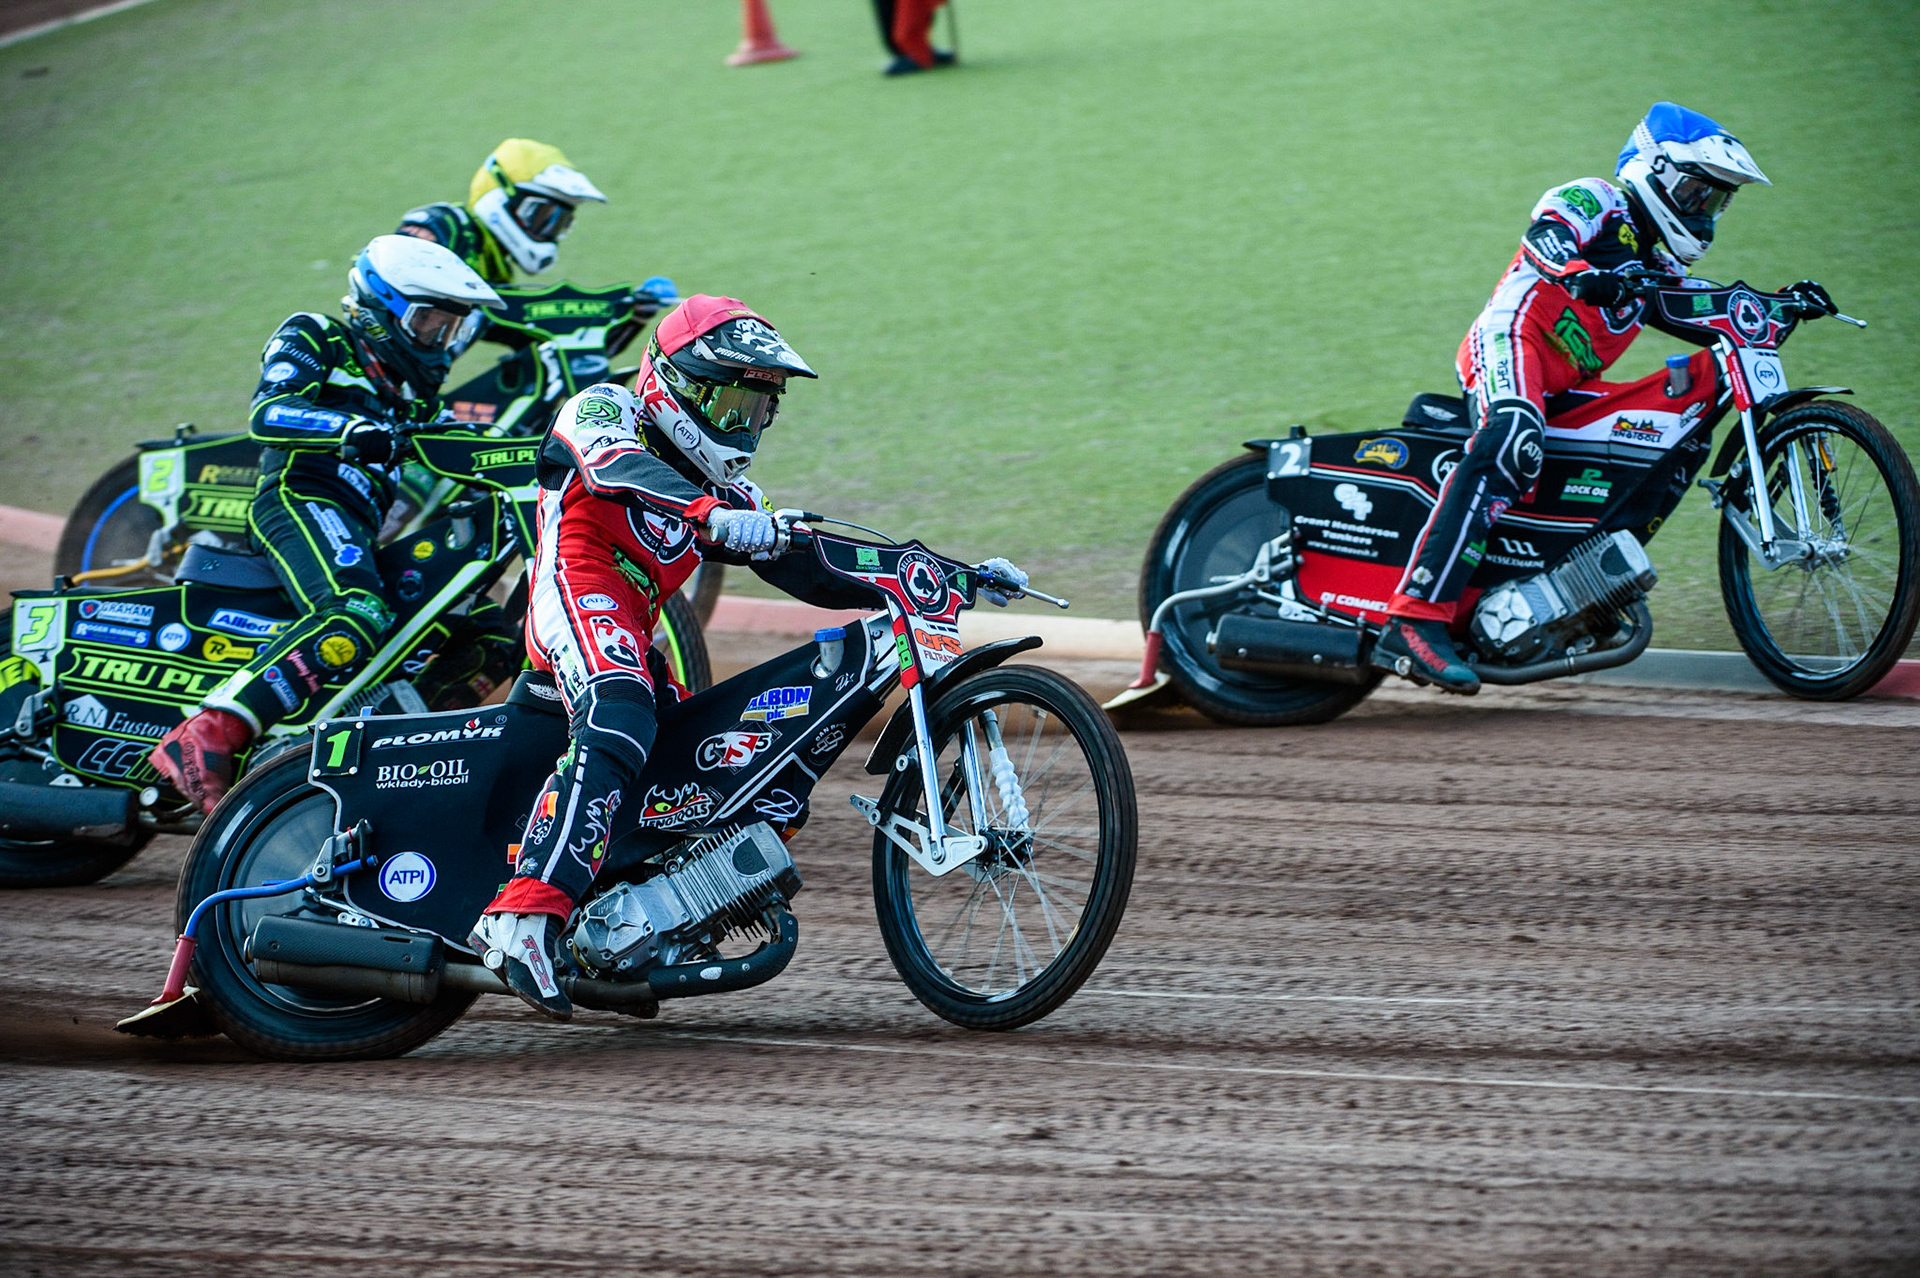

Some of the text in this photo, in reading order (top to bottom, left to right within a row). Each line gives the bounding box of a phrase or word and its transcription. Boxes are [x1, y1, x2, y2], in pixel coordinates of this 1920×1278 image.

[677, 425, 697, 445] ATPI
[480, 451, 515, 466] TRU
[1279, 443, 1302, 476] 2
[148, 457, 176, 492] 2
[1563, 485, 1592, 495] ROCK
[1294, 515, 1399, 539] Grant Henderson
[1322, 529, 1373, 545] Tankers
[914, 554, 929, 564] VUE
[20, 606, 56, 645] 3
[217, 614, 271, 632] Allied
[81, 656, 158, 686] TRU
[746, 687, 812, 709] ALBON
[766, 709, 786, 722] plc
[326, 730, 352, 767] 1
[388, 868, 425, 885] ATPI
